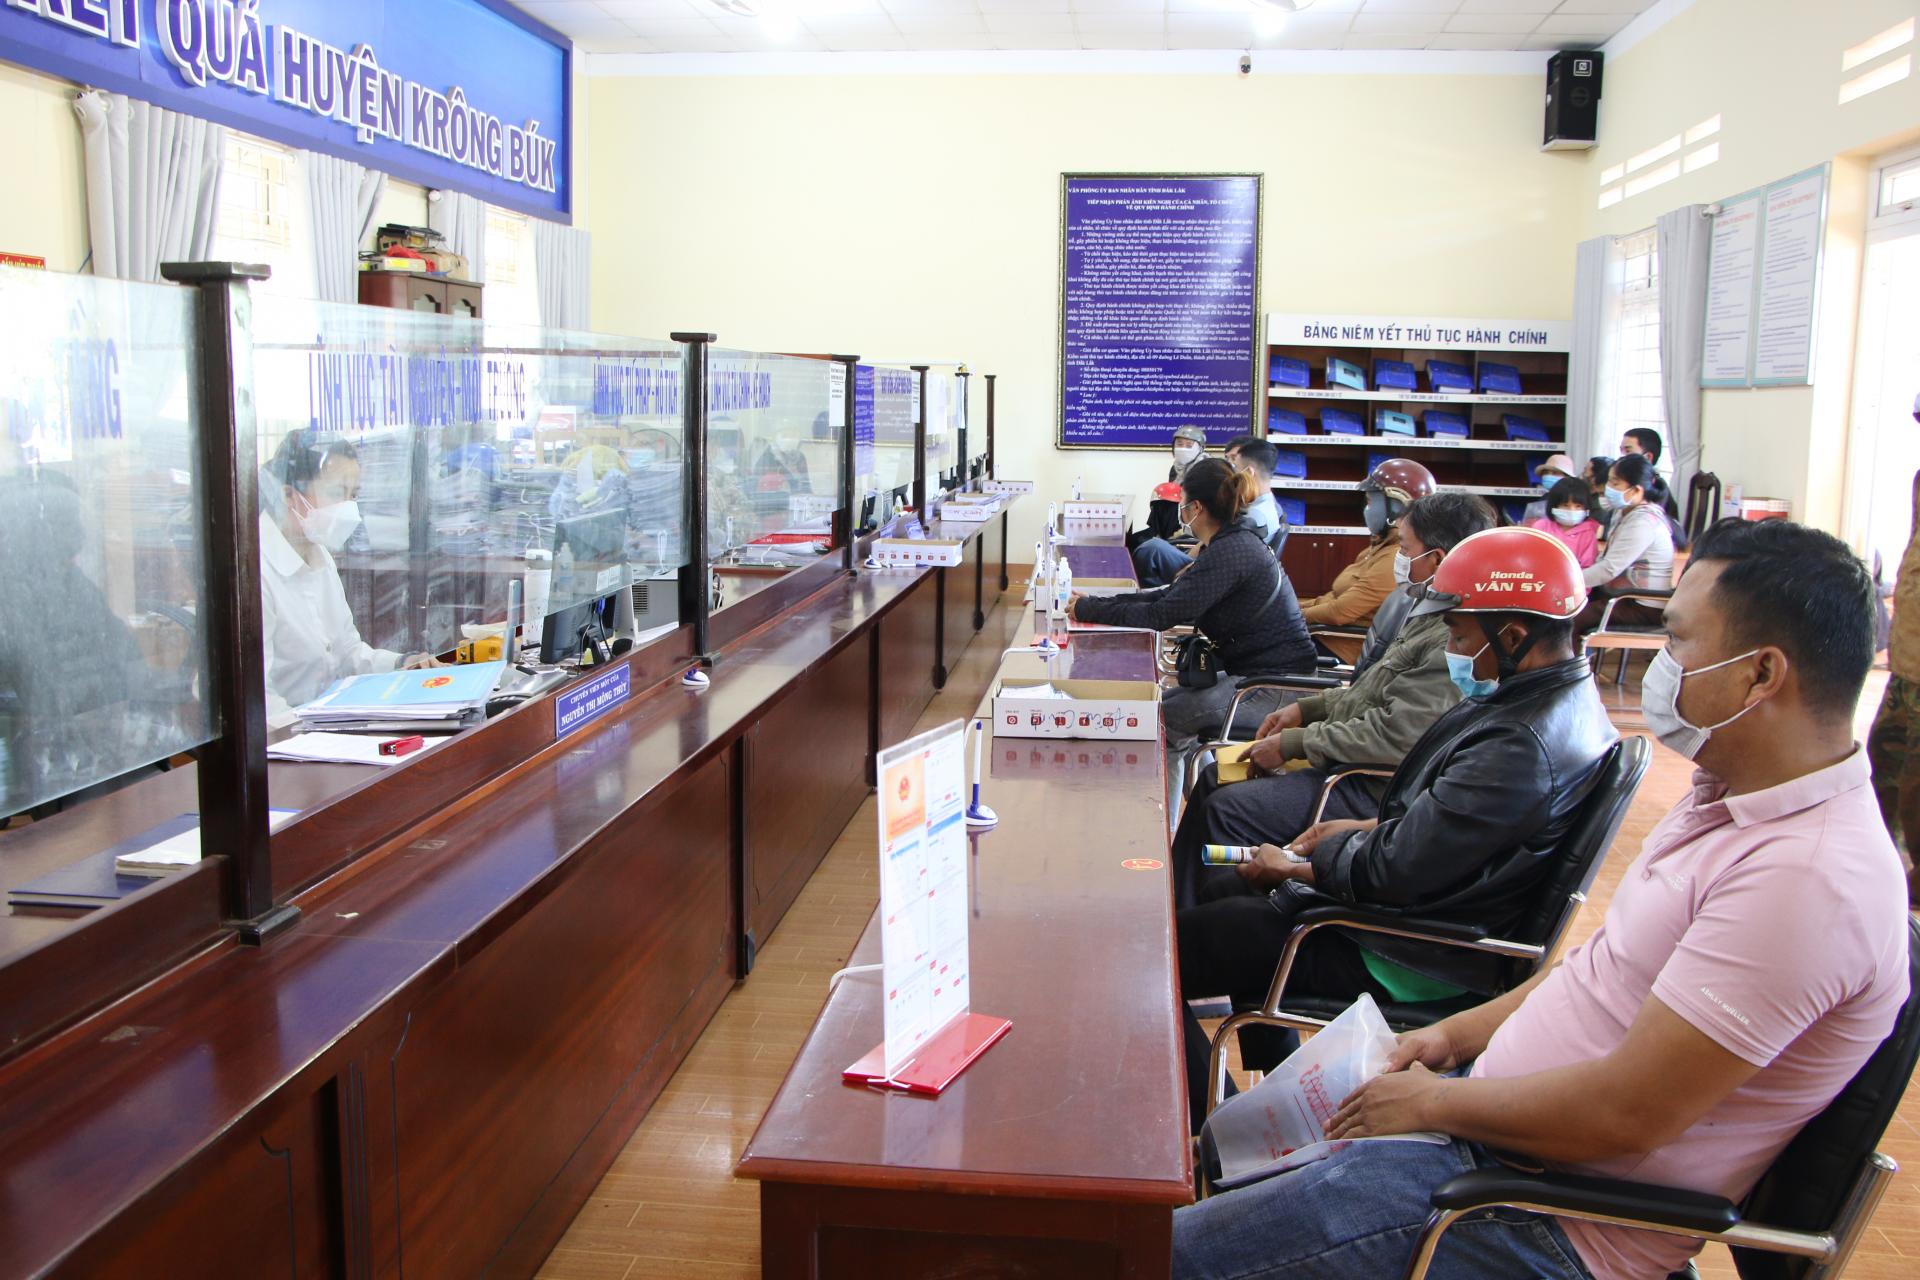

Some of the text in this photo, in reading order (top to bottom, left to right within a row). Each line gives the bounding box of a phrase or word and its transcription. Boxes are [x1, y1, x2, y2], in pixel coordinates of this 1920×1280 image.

[280, 25, 402, 144] HUYỆN
[410, 82, 503, 176] KRÔNG
[508, 120, 556, 193] BÚK
[1303, 321, 1547, 346] BẢNG NIÊM YẾT THỦ TỤC HÀNH CHÍNH
[309, 333, 343, 431] LĨNH
[347, 339, 376, 448] VỰC
[380, 344, 404, 426] TÀI
[1490, 571, 1534, 580] Honda
[1474, 581, 1514, 592] VĂN
[586, 699, 596, 712] THỊ
